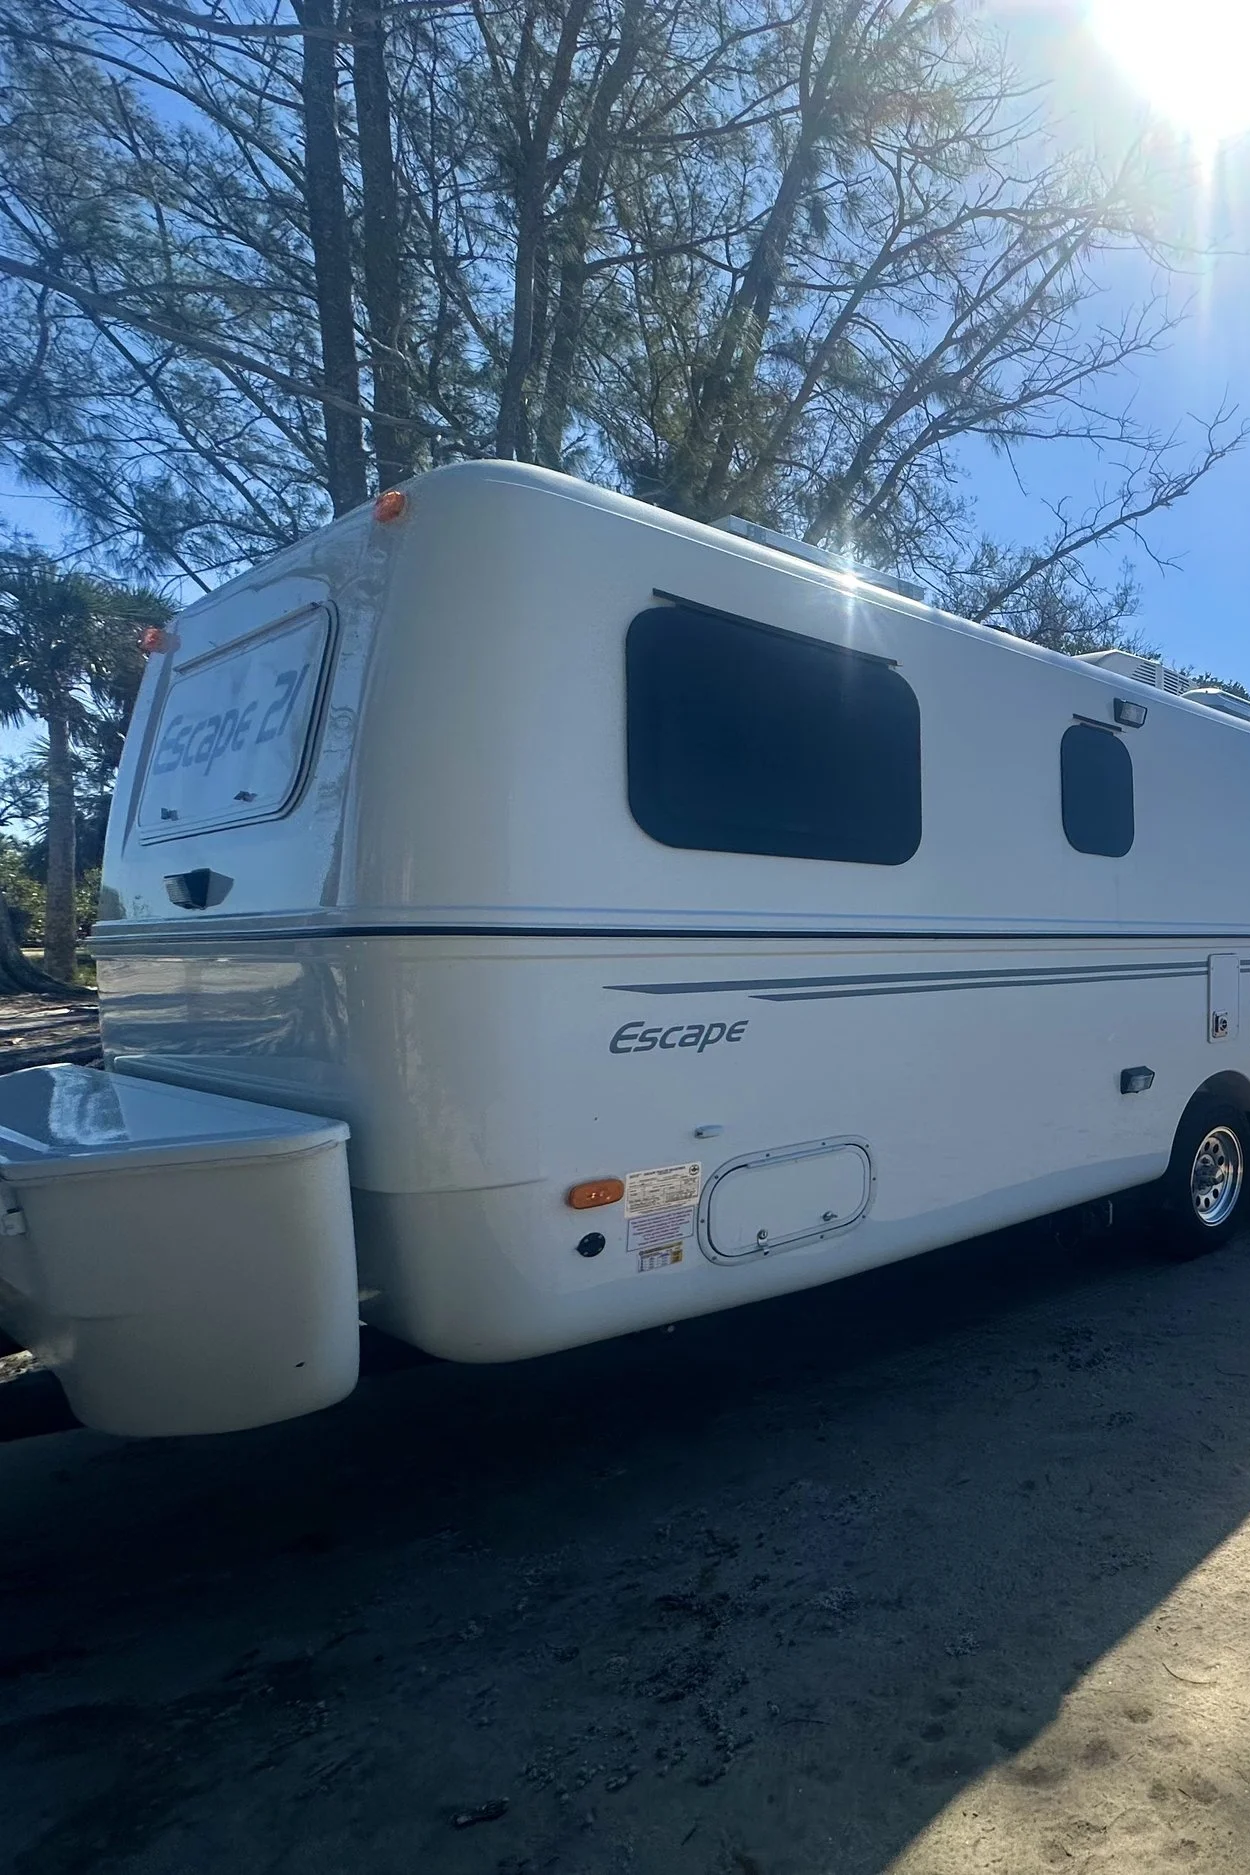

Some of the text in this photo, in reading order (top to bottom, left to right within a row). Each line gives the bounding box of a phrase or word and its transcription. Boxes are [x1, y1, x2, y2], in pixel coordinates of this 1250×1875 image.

[153, 664, 310, 776] Escape 21
[609, 1020, 749, 1054] Escape
